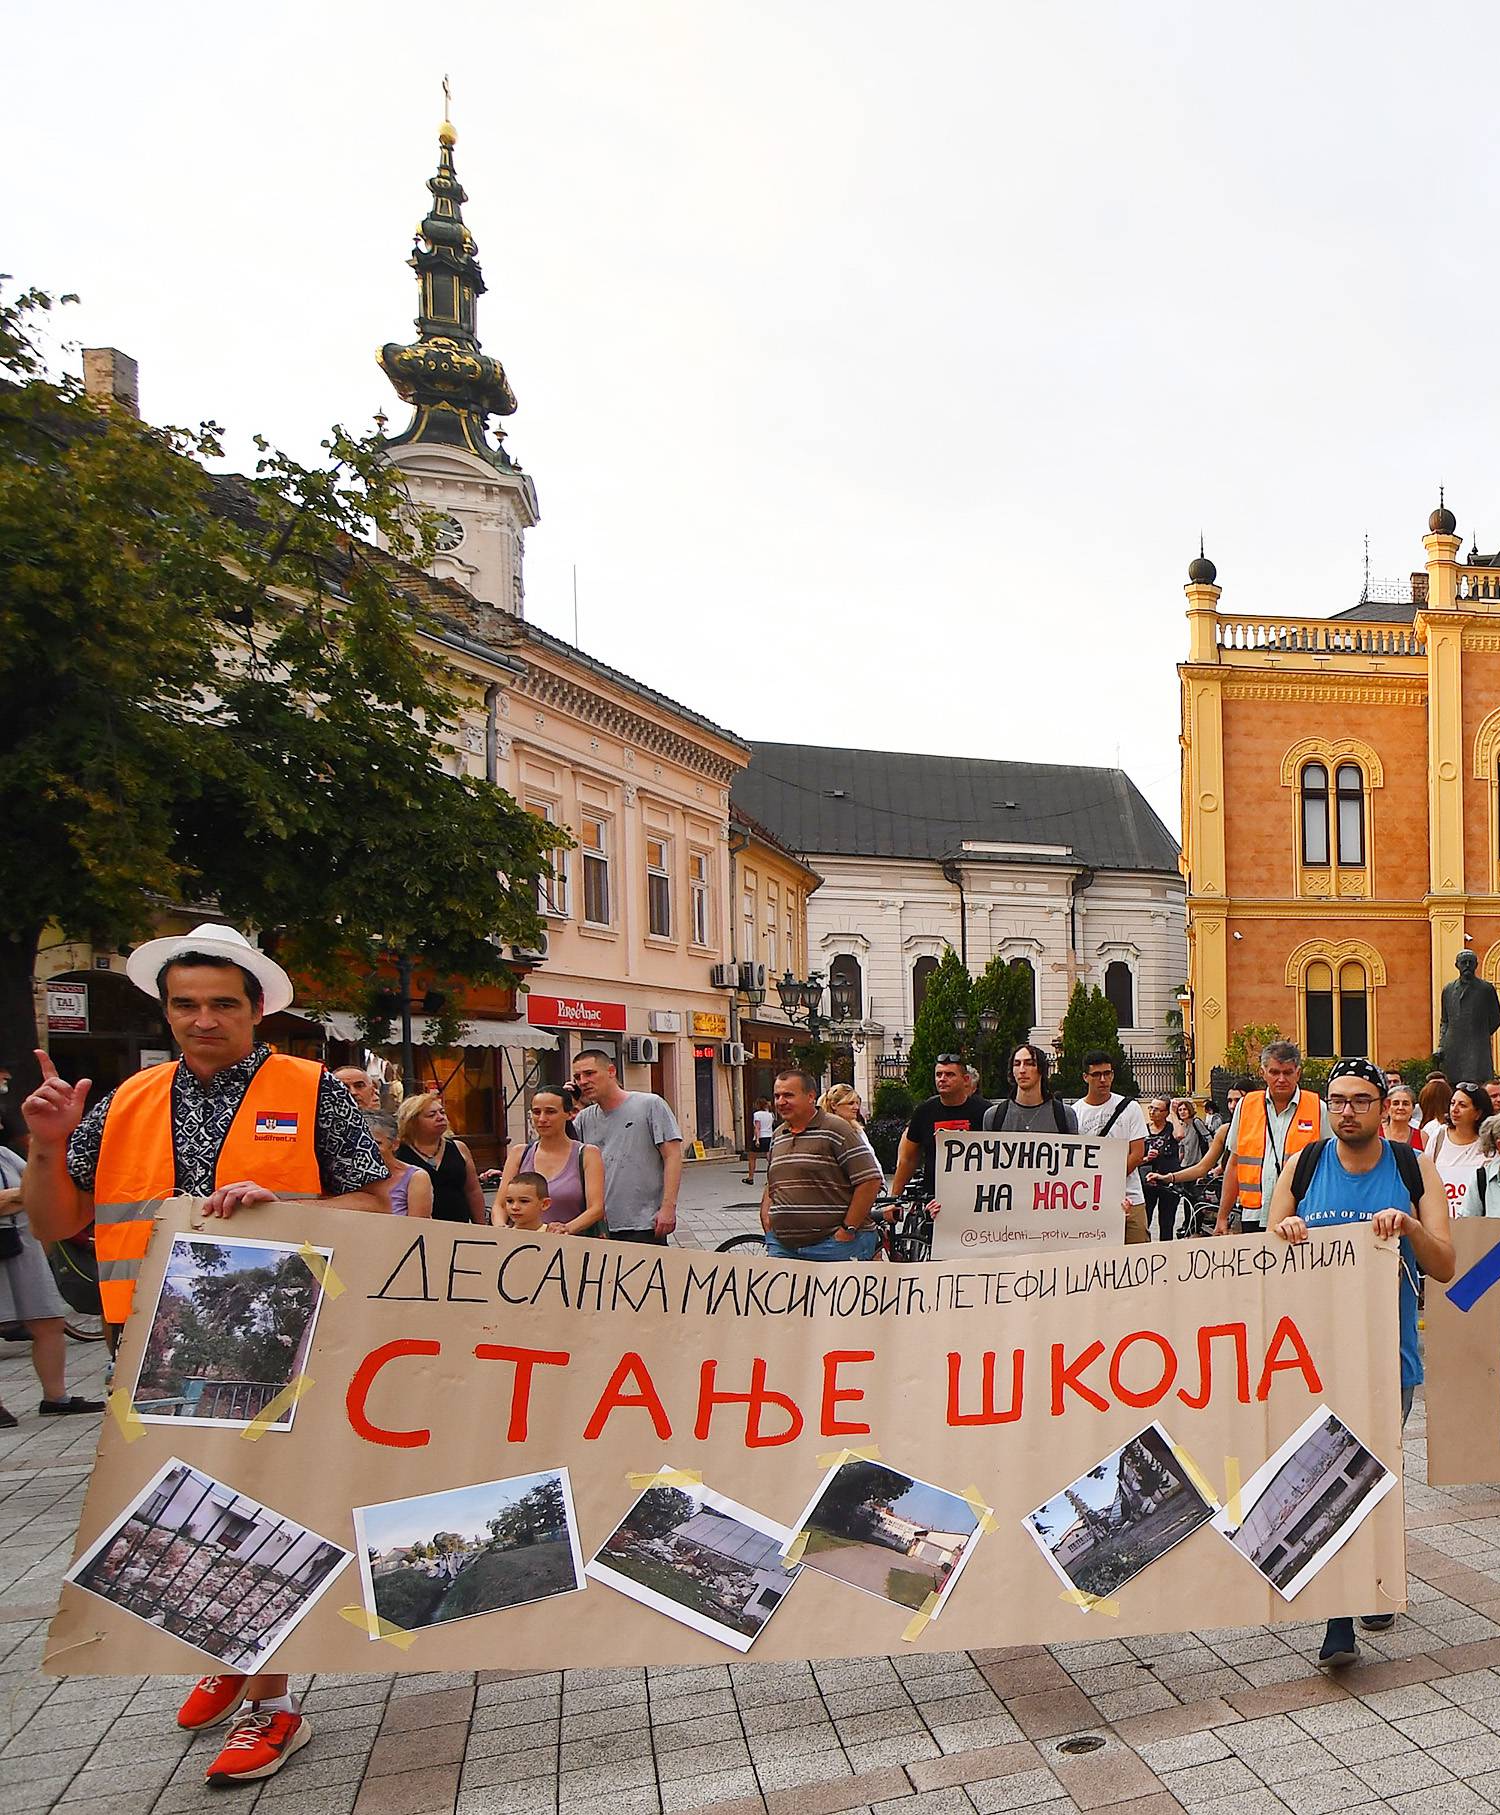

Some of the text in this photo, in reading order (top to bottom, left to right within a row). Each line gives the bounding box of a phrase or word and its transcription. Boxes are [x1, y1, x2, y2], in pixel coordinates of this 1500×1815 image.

[973, 1175, 1103, 1213] НА НАС!
[1305, 1210, 1373, 1222] OCEAN OF DR
[366, 1234, 669, 1313] ДЕСАНКА
[935, 1267, 1057, 1312] ПЕТЕФИ
[1178, 1245, 1278, 1283] ЈОЖЕФ
[1281, 1239, 1356, 1274] АТИЛА
[346, 1316, 1325, 1449] СТАЊЕ ШКОЛА
